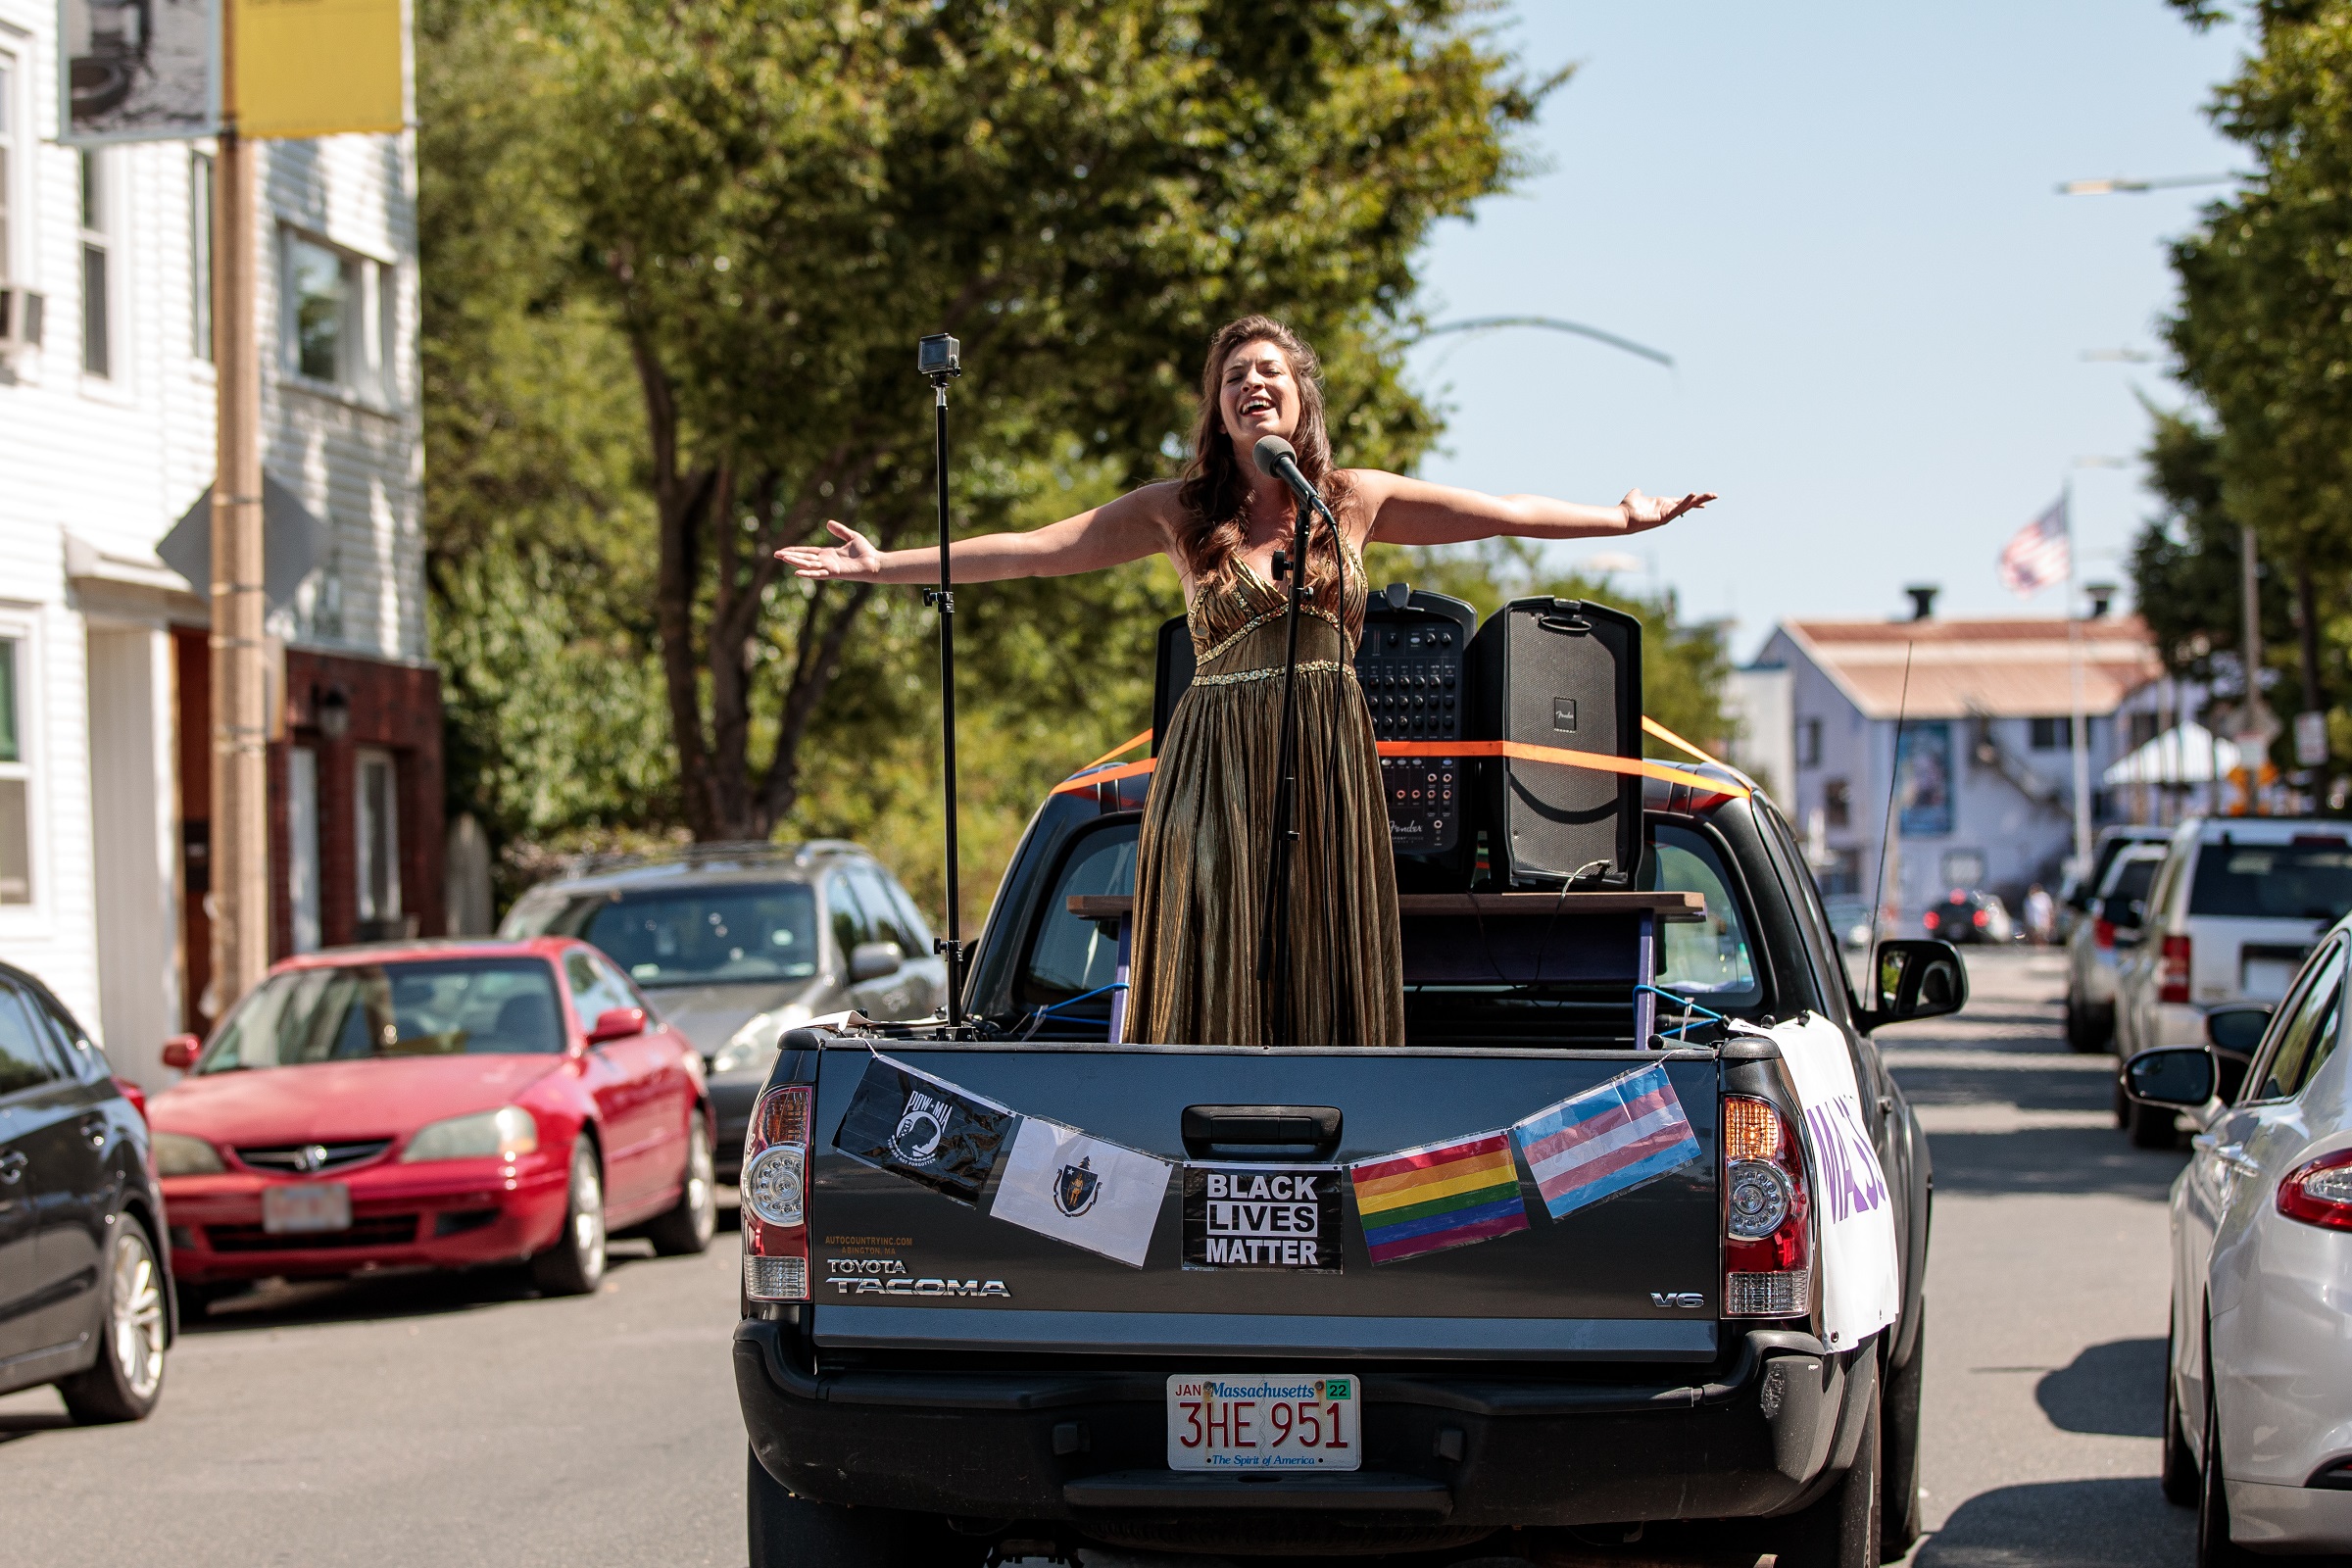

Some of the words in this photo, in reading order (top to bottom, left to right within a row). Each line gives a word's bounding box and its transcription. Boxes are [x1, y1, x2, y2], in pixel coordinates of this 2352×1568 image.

[1389, 819, 1423, 834] Fender
[902, 1090, 933, 1116] POW
[932, 1101, 953, 1133] MIA
[908, 1157, 936, 1167] FORGOTTEN
[1206, 1173, 1318, 1200] BLACK
[1209, 1203, 1315, 1233] LIVES
[824, 1236, 913, 1247] AUTOCOUNTRYINC.COM
[841, 1247, 881, 1255] ABINGTON,
[1205, 1238, 1319, 1265] MATTER
[827, 1258, 906, 1274] TOYOTA
[825, 1277, 1011, 1298] TACOMA
[1650, 1293, 1704, 1308] V6
[1175, 1384, 1201, 1396] JAN
[1209, 1382, 1315, 1398] Massachusetts
[1329, 1384, 1348, 1396] 22
[1179, 1401, 1257, 1448] 3HE
[1270, 1401, 1348, 1448] 951
[1212, 1454, 1230, 1465] The
[1233, 1454, 1259, 1467] Spirit
[1262, 1454, 1273, 1467] of
[1273, 1455, 1315, 1466] America
